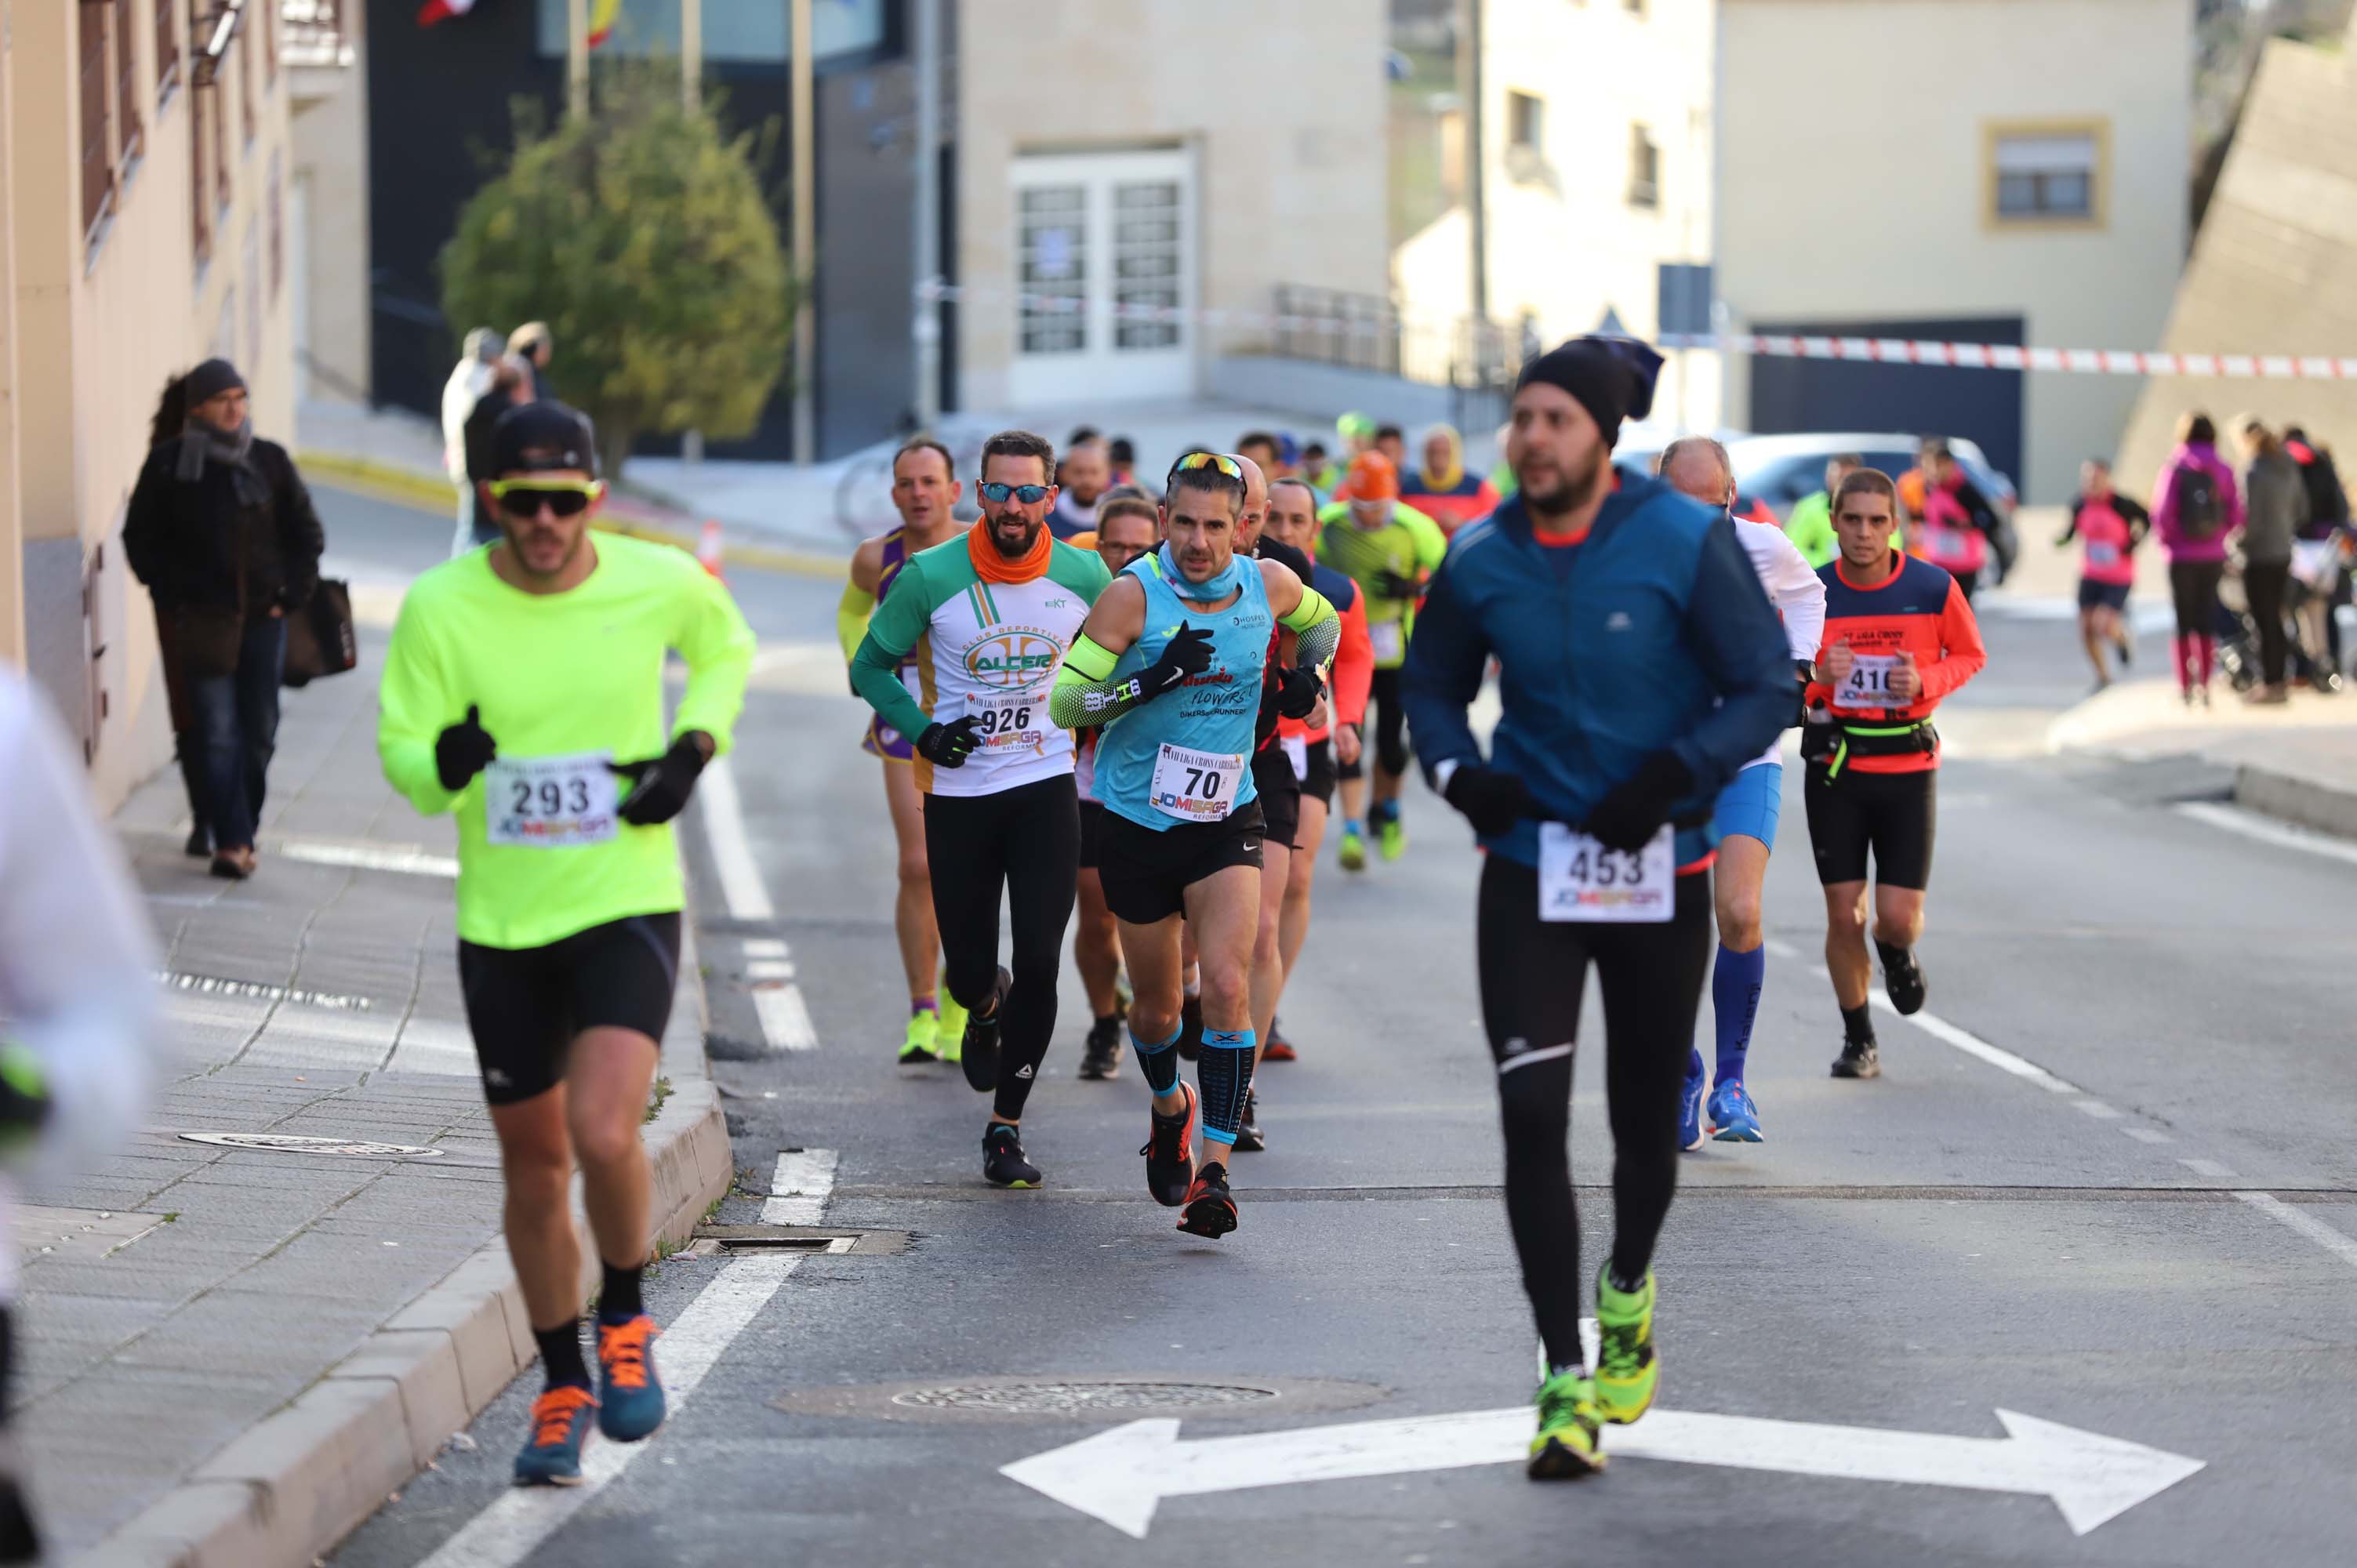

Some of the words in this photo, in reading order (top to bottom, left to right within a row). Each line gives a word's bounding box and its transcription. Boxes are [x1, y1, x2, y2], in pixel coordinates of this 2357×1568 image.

[961, 631, 992, 651] CLUB
[998, 626, 1064, 647] DEPORTIVO
[975, 653, 1053, 670] ALCER
[981, 706, 1031, 735] 926
[511, 779, 590, 815] 293
[1186, 767, 1221, 800] 70
[1158, 791, 1229, 815] JOMISAGA
[1569, 845, 1644, 885] 453
